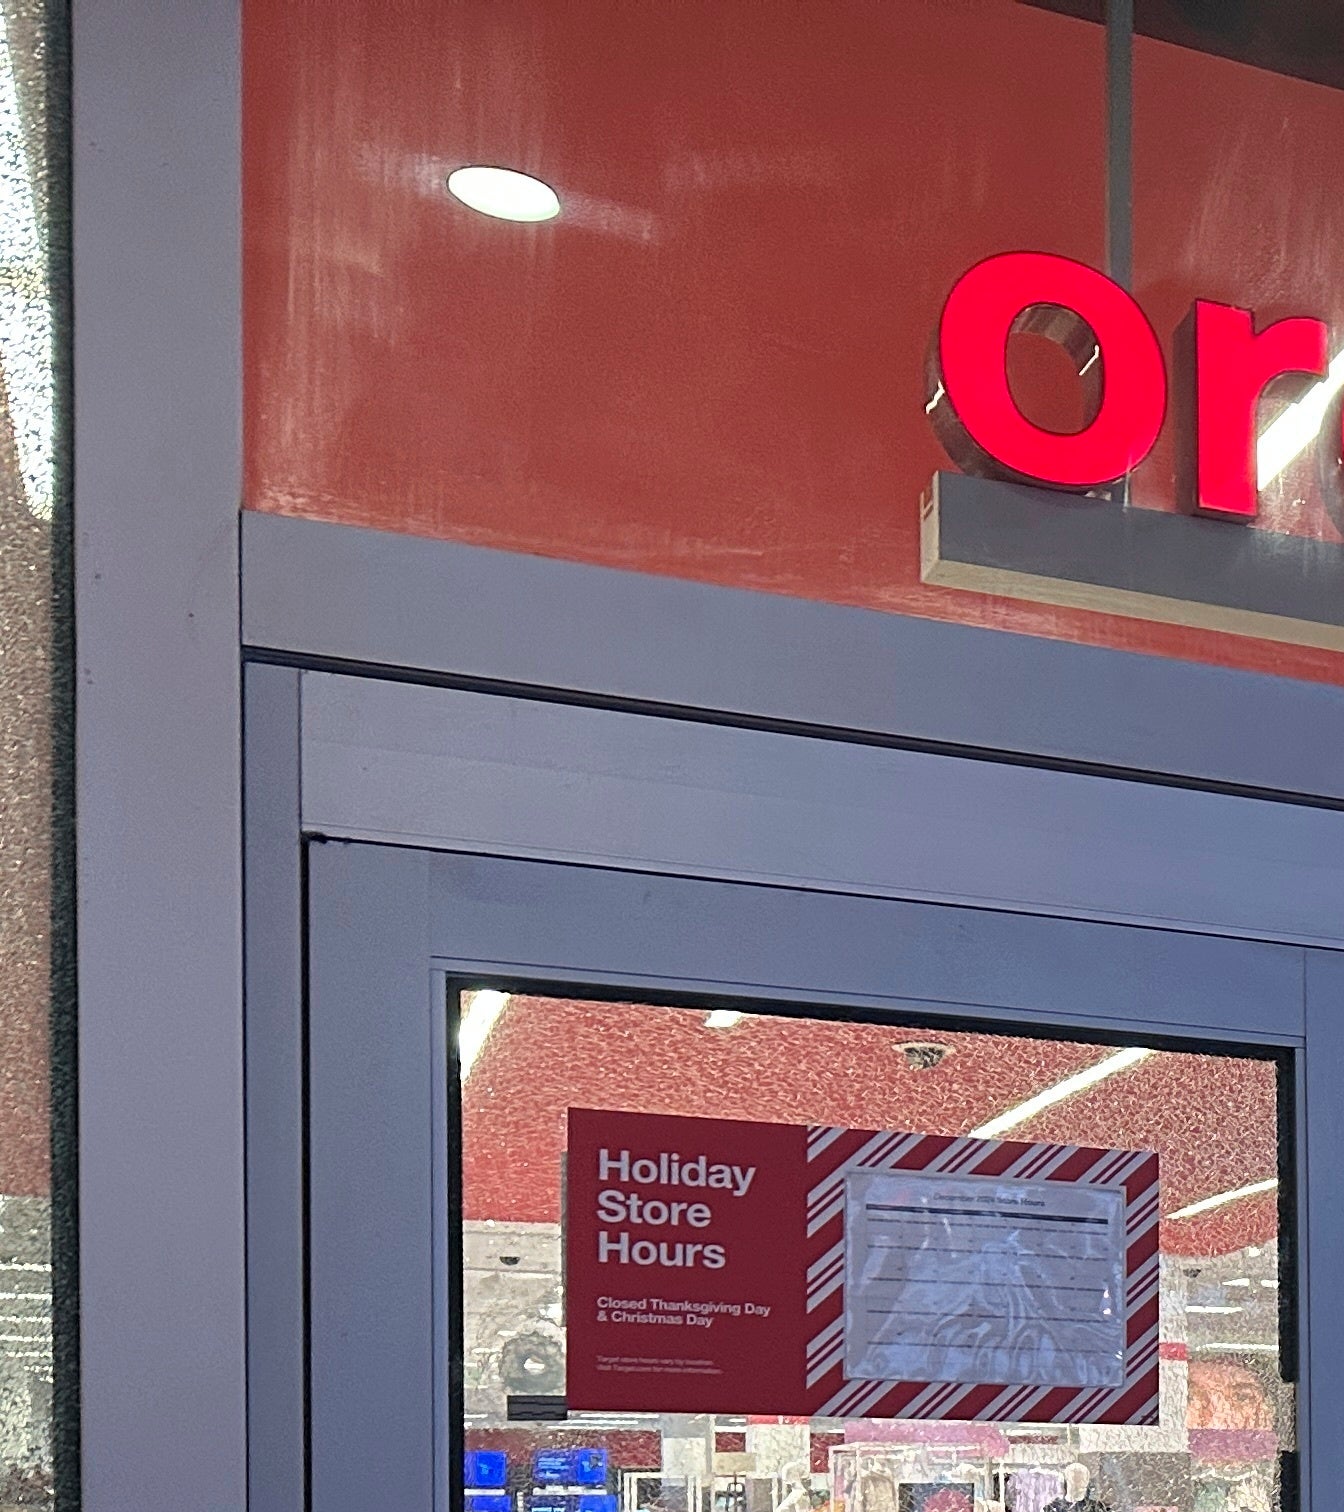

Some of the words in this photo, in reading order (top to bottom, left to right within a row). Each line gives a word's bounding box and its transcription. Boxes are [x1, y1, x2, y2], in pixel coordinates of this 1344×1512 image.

[598, 1148, 756, 1197] Holiday
[596, 1189, 712, 1228] Store
[598, 1230, 726, 1269] Hours
[596, 1296, 647, 1310] Closed
[650, 1298, 741, 1317] Thanksgiving
[744, 1302, 771, 1318] Day
[596, 1310, 608, 1322] &
[611, 1311, 683, 1325] Christmas
[686, 1313, 714, 1329] Day
